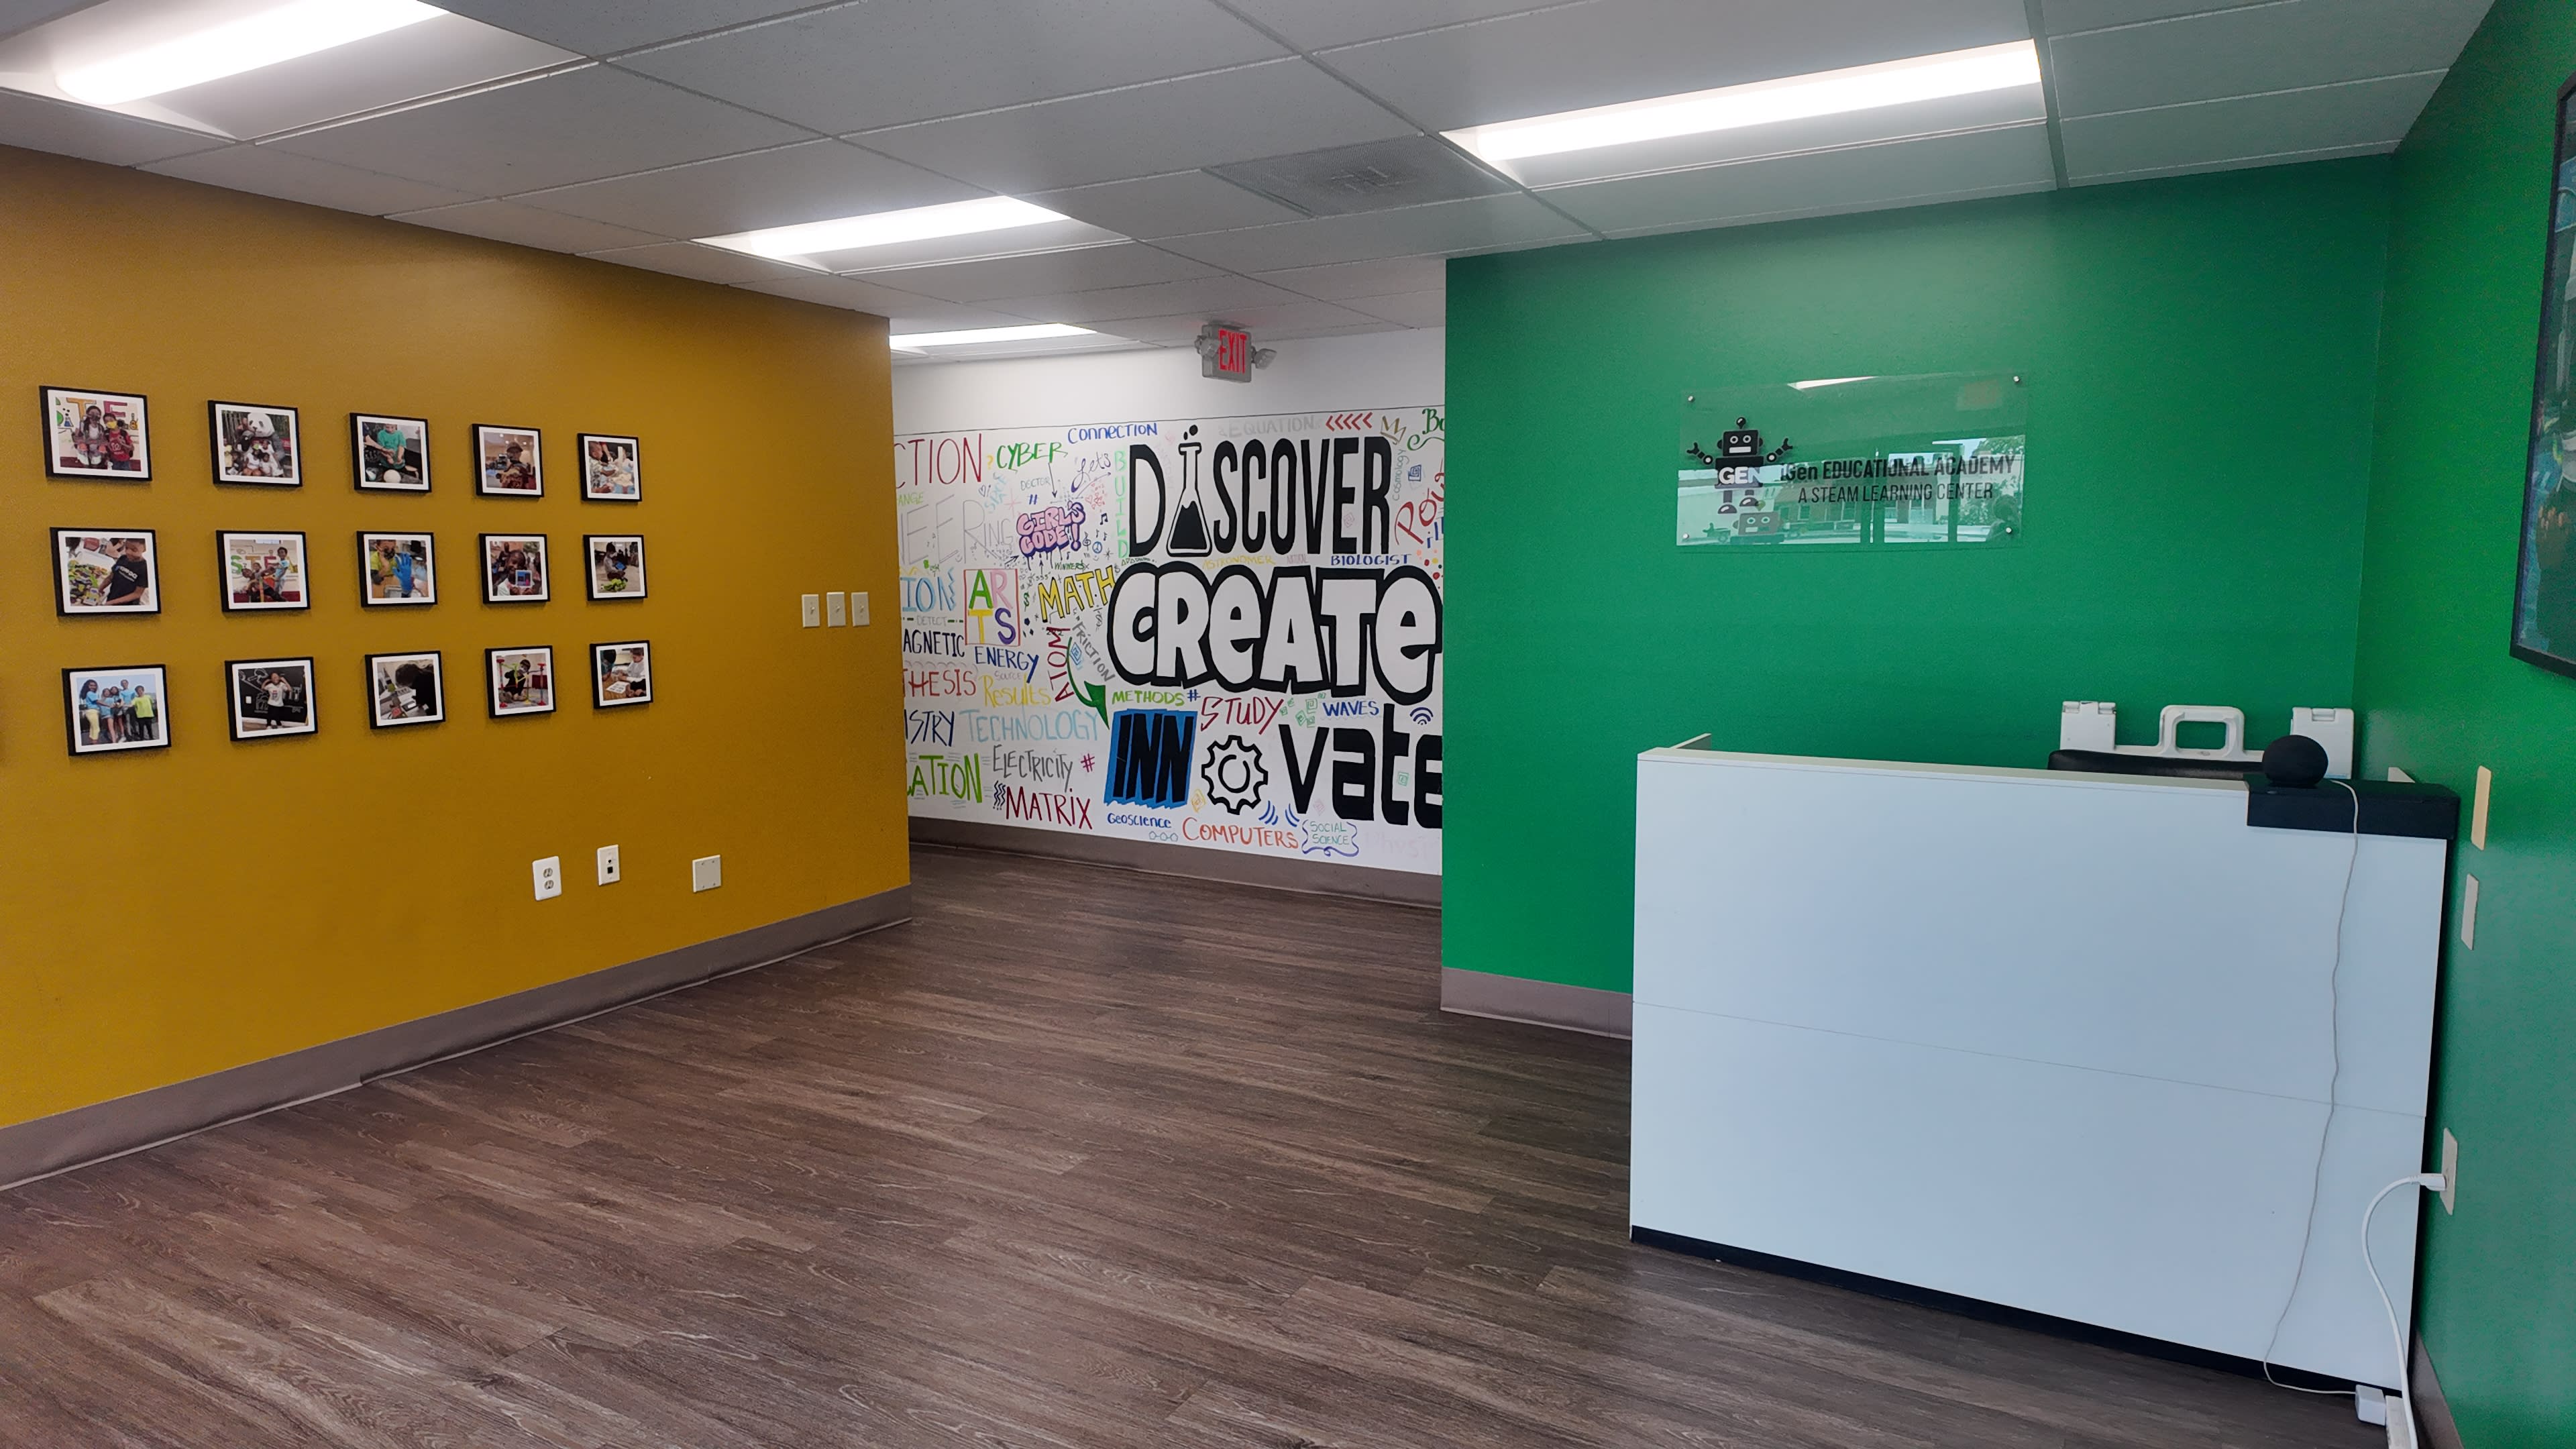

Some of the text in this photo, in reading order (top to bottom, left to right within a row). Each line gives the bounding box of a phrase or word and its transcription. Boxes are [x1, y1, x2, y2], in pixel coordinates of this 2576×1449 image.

[1218, 328, 1247, 374] EXIT
[1068, 423, 1158, 444] Connection
[996, 441, 1069, 472] CYBER
[1780, 454, 2015, 481] iGen EDUCATIONAL ACADEMY
[1798, 482, 1993, 503] A STEAM LEARNING CENTER
[1331, 553, 1412, 566] BIOLOGIST
[1038, 566, 1115, 623] MATH
[975, 646, 1039, 684] ENERGY
[1046, 627, 1074, 702] ATOM
[1112, 690, 1185, 706] METHODS
[1322, 700, 1380, 718] WAVES
[959, 708, 1099, 743] TECHNOLOGY
[1200, 695, 1285, 735] STUDY
[1182, 816, 1299, 850] COMPUTERS
[1309, 820, 1347, 833] SOCIAL
